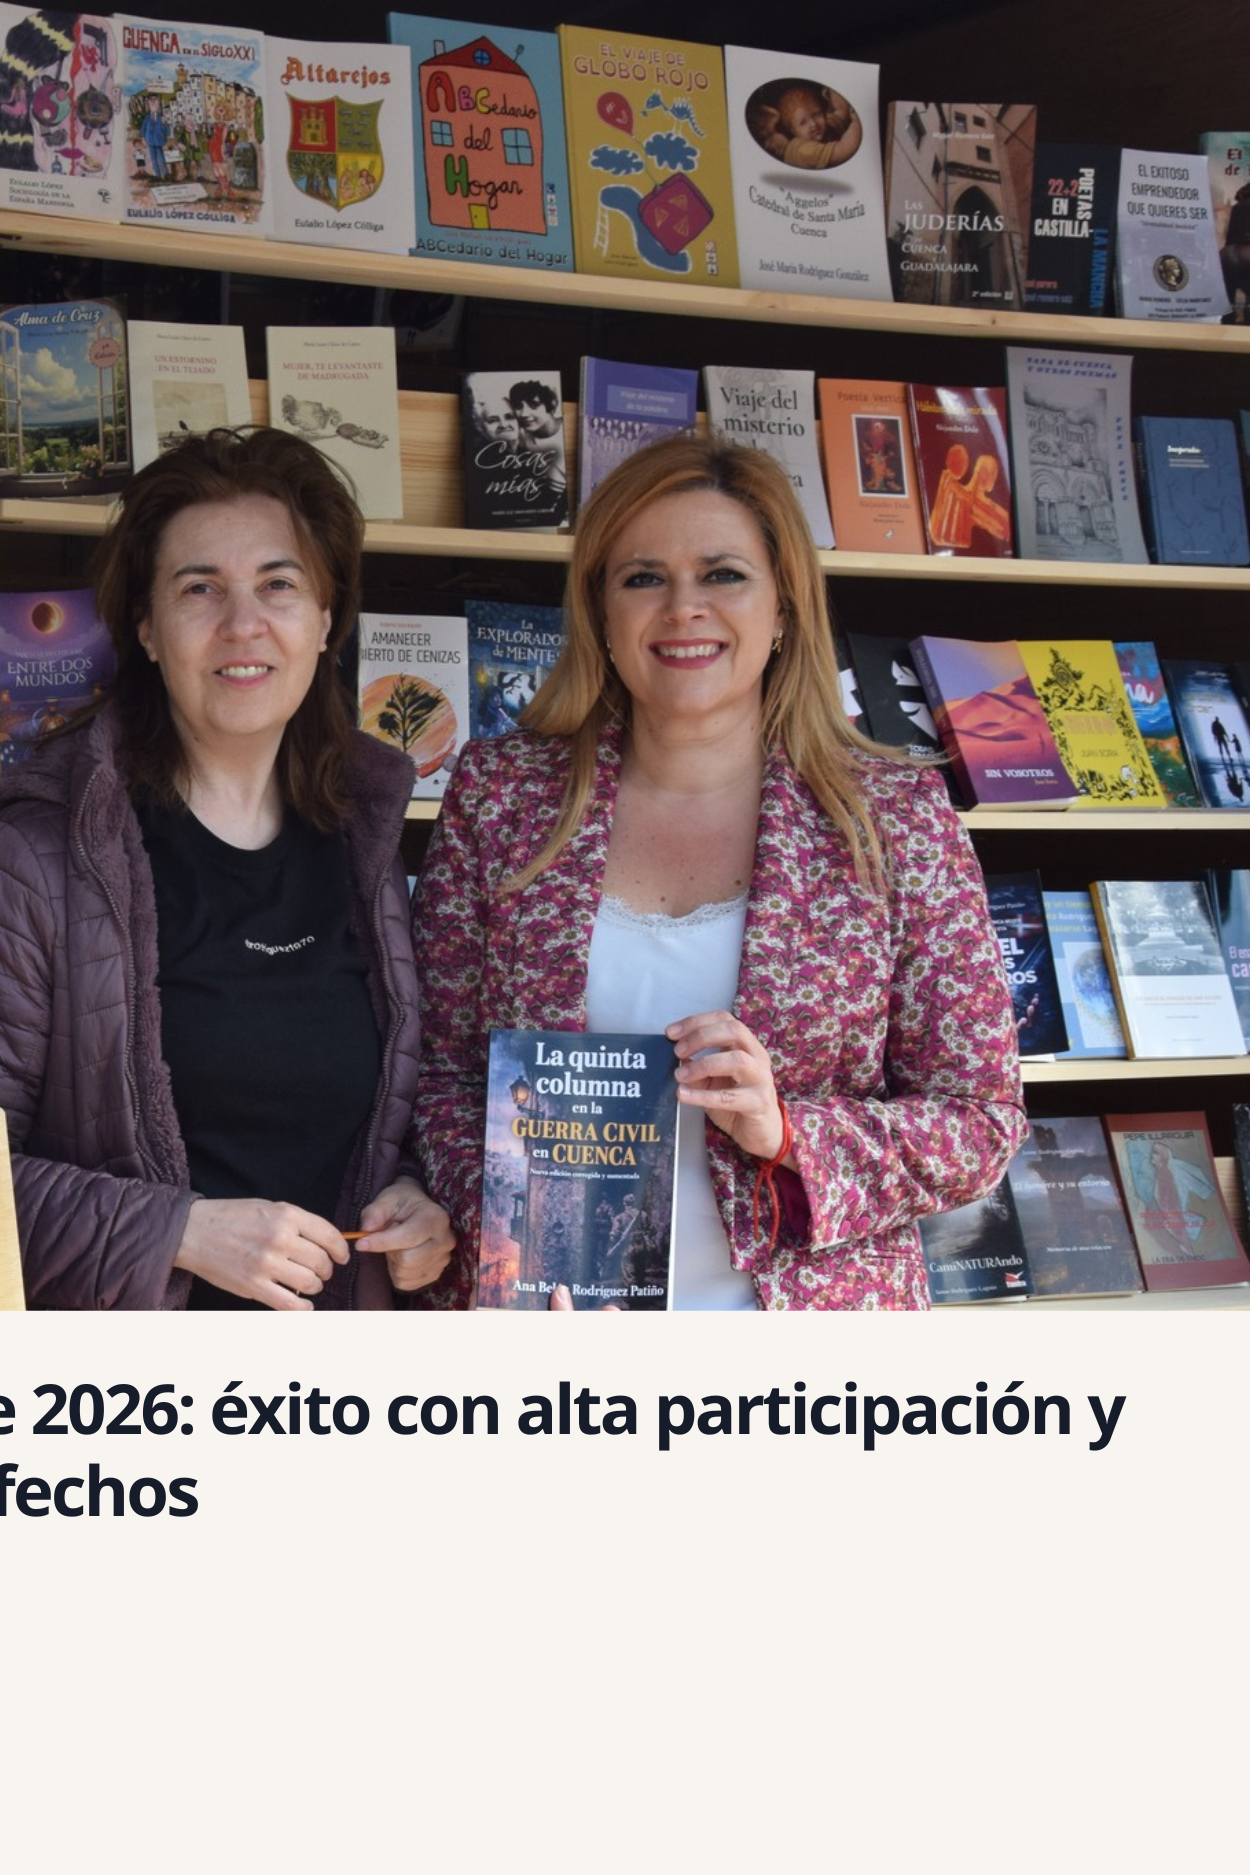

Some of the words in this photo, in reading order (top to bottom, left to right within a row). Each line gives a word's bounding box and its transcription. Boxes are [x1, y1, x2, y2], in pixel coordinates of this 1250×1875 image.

[123, 26, 180, 55] CUENCA
[600, 43, 616, 57] EL
[624, 47, 661, 65] VIAJE
[667, 51, 685, 67] DE
[280, 56, 391, 89] Altarejos
[573, 55, 646, 83] GLOBO
[655, 68, 710, 92] ROJO
[426, 71, 538, 120] ABCedario
[464, 126, 494, 151] del
[1138, 164, 1148, 177] EL
[1151, 166, 1189, 181] EXITOSO
[444, 154, 522, 211] Hogar
[1131, 182, 1199, 200] EMPRENDEDOR
[749, 185, 790, 217] Catedral
[793, 206, 805, 220] de
[808, 211, 835, 222] Santa
[838, 202, 865, 222] María
[1076, 168, 1095, 221] POETAS
[1052, 198, 1068, 216] EN
[1127, 201, 1146, 215] QUE
[1148, 204, 1187, 219] QUIERES
[1189, 206, 1208, 220] SER
[294, 218, 323, 230] Eulalio
[326, 219, 352, 234] López
[354, 220, 385, 232] Cólliga
[790, 223, 827, 238] Cuenca
[904, 211, 1004, 232] JUDERÍAS
[1093, 228, 1109, 246] LA
[416, 238, 492, 259] ABCedario
[499, 243, 521, 261] del
[527, 247, 569, 266] Hogar
[759, 259, 775, 272] José
[1090, 249, 1108, 309] MANCHA
[14, 312, 48, 326] Alma
[52, 310, 66, 324] de
[71, 308, 103, 324] Cruz
[154, 354, 167, 363] UN
[169, 355, 217, 365] ESTORNINO
[316, 362, 326, 370] TE
[328, 362, 383, 371] LEVANTASTE
[158, 365, 170, 373] EN
[171, 366, 182, 374] EL
[183, 366, 216, 376] TEJADO
[298, 372, 309, 380] DE
[312, 372, 369, 380] MADRUGADA
[720, 387, 766, 412] Viaje
[771, 389, 798, 410] del
[724, 414, 805, 437] misterio
[475, 441, 556, 476] Cosas
[485, 474, 549, 502] mías
[521, 619, 533, 630] La
[371, 631, 431, 647] AMANECER
[398, 649, 413, 663] DE
[417, 650, 461, 664] CENIZAS
[492, 647, 504, 657] de
[8, 660, 58, 674] ENTRE
[61, 656, 93, 672] DOS
[15, 671, 87, 687] MUNDOS
[985, 768, 1002, 778] SIN
[1004, 768, 1055, 778] VOSOTROS
[536, 1042, 564, 1066] La
[568, 1045, 646, 1072] quinta
[536, 1071, 642, 1098] columna
[572, 1103, 588, 1114] en
[591, 1102, 603, 1115] la
[511, 1118, 598, 1141] GUERRA
[603, 1122, 661, 1143] CIVIL
[533, 1148, 549, 1159] en
[552, 1143, 637, 1166] CUENCA
[530, 1167, 548, 1176] Nueva
[549, 1168, 571, 1176] edición
[572, 1170, 601, 1180] corregida
[607, 1172, 640, 1180] aumentada
[1058, 1181, 1066, 1191] y
[513, 1279, 536, 1292] Ana
[572, 1284, 628, 1299] Rodríguez
[630, 1286, 665, 1296] Patiño
